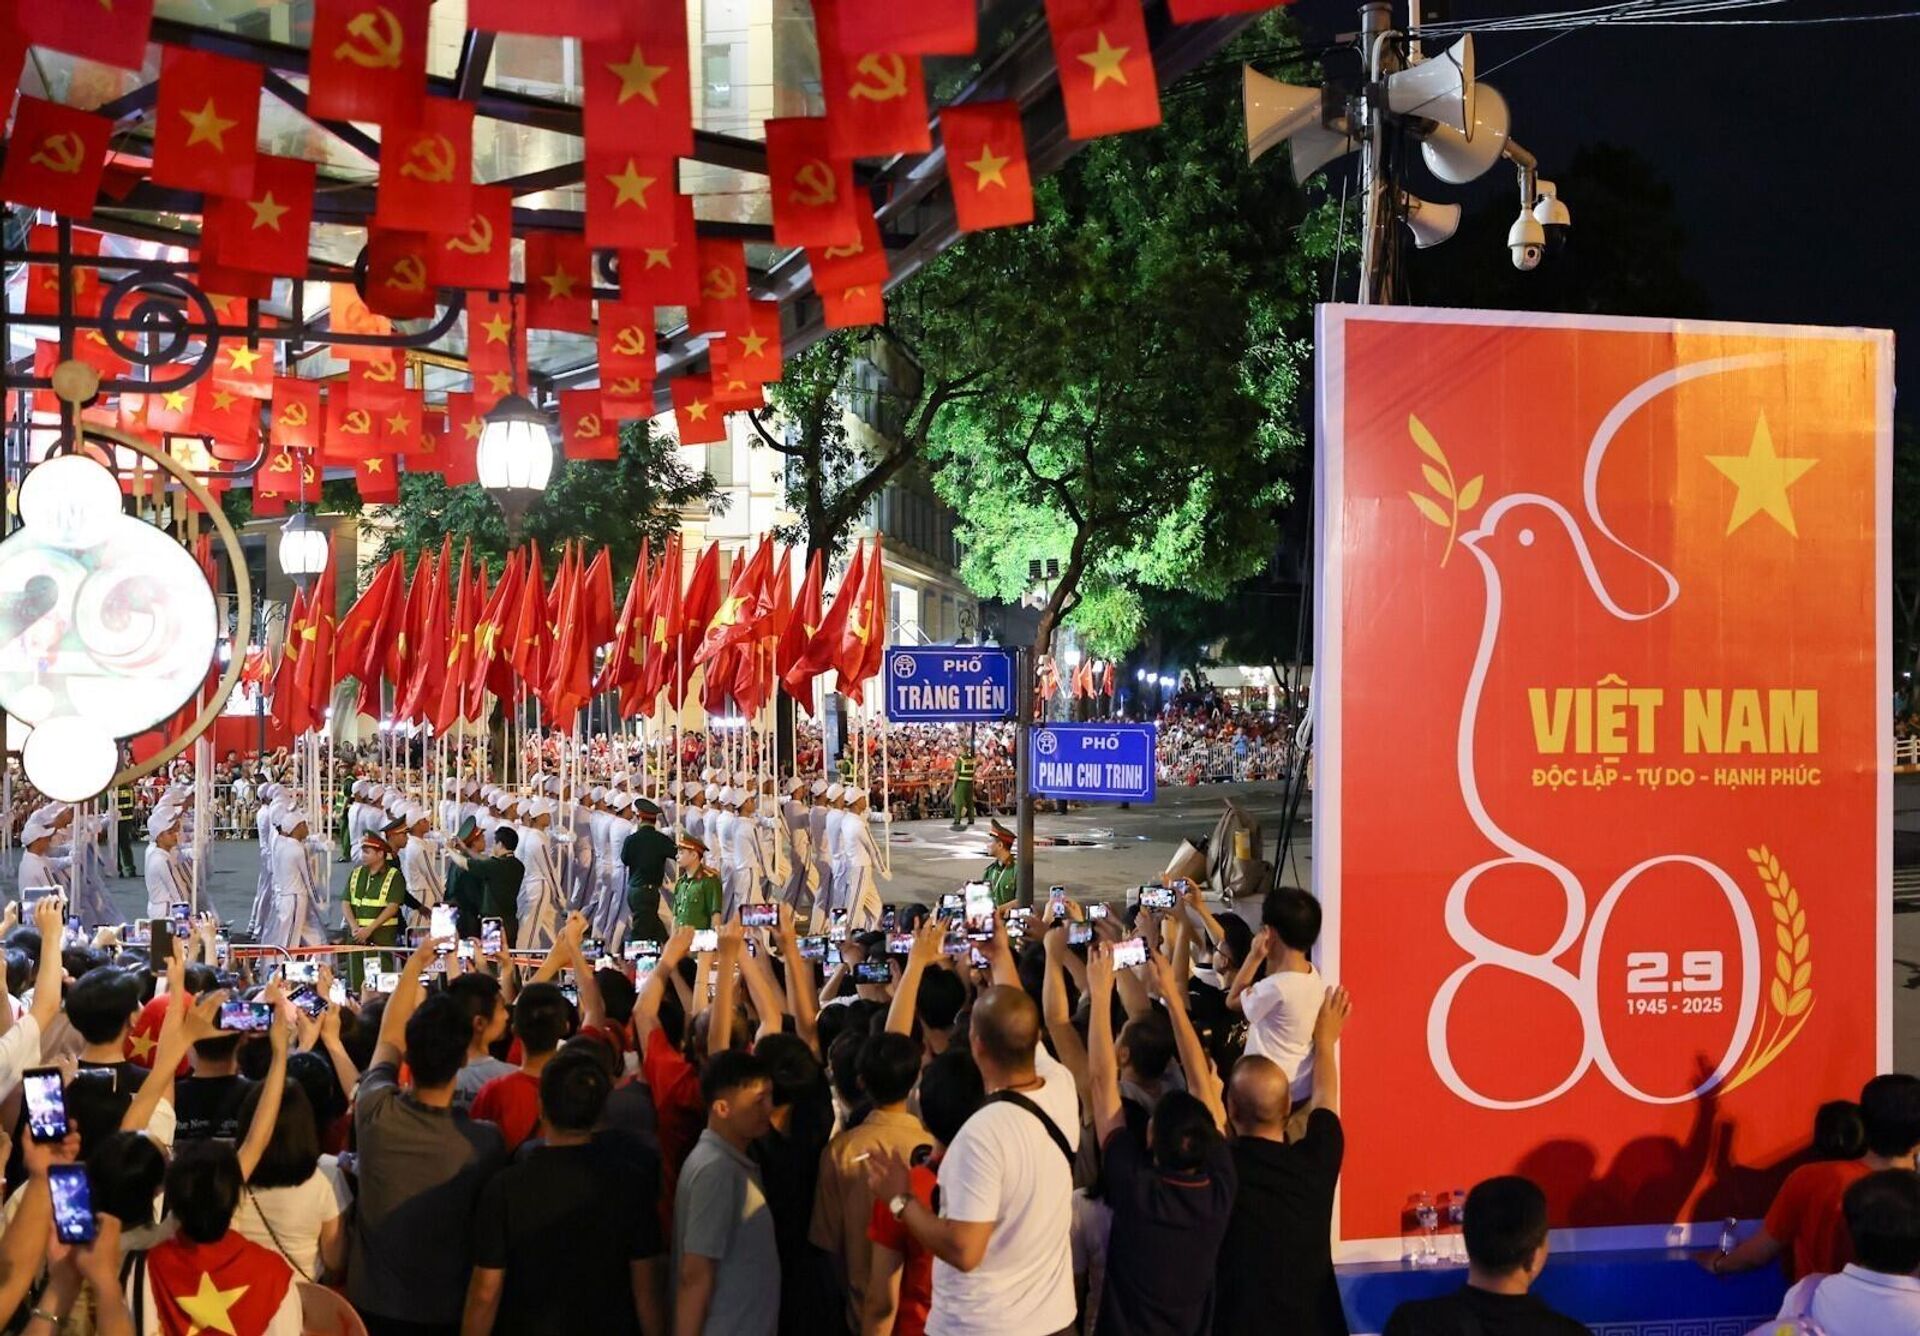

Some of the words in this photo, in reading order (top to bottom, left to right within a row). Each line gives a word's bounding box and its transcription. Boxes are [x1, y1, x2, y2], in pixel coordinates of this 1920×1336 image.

[943, 655, 983, 672] PHỐ
[897, 678, 960, 710] TRÀNG
[965, 676, 1005, 710] TIỀN
[1528, 673, 1664, 764] VIỆT
[1683, 688, 1819, 754] NAM
[1082, 732, 1120, 750] PHỐ
[1039, 762, 1073, 787] PHAN
[1077, 763, 1102, 788] CHU
[1105, 763, 1143, 790] TRINH
[1532, 764, 1577, 791] ĐỘC
[1583, 764, 1618, 791] LẬP
[1636, 766, 1664, 791] TỰ
[1666, 768, 1695, 787] DO
[1714, 768, 1766, 790] HẠNH
[1771, 764, 1821, 787] PHÚC
[1427, 854, 1761, 1111] 80
[1627, 951, 1723, 993] 2.9
[1627, 999, 1667, 1015] 1945
[1682, 997, 1723, 1014] 2025
